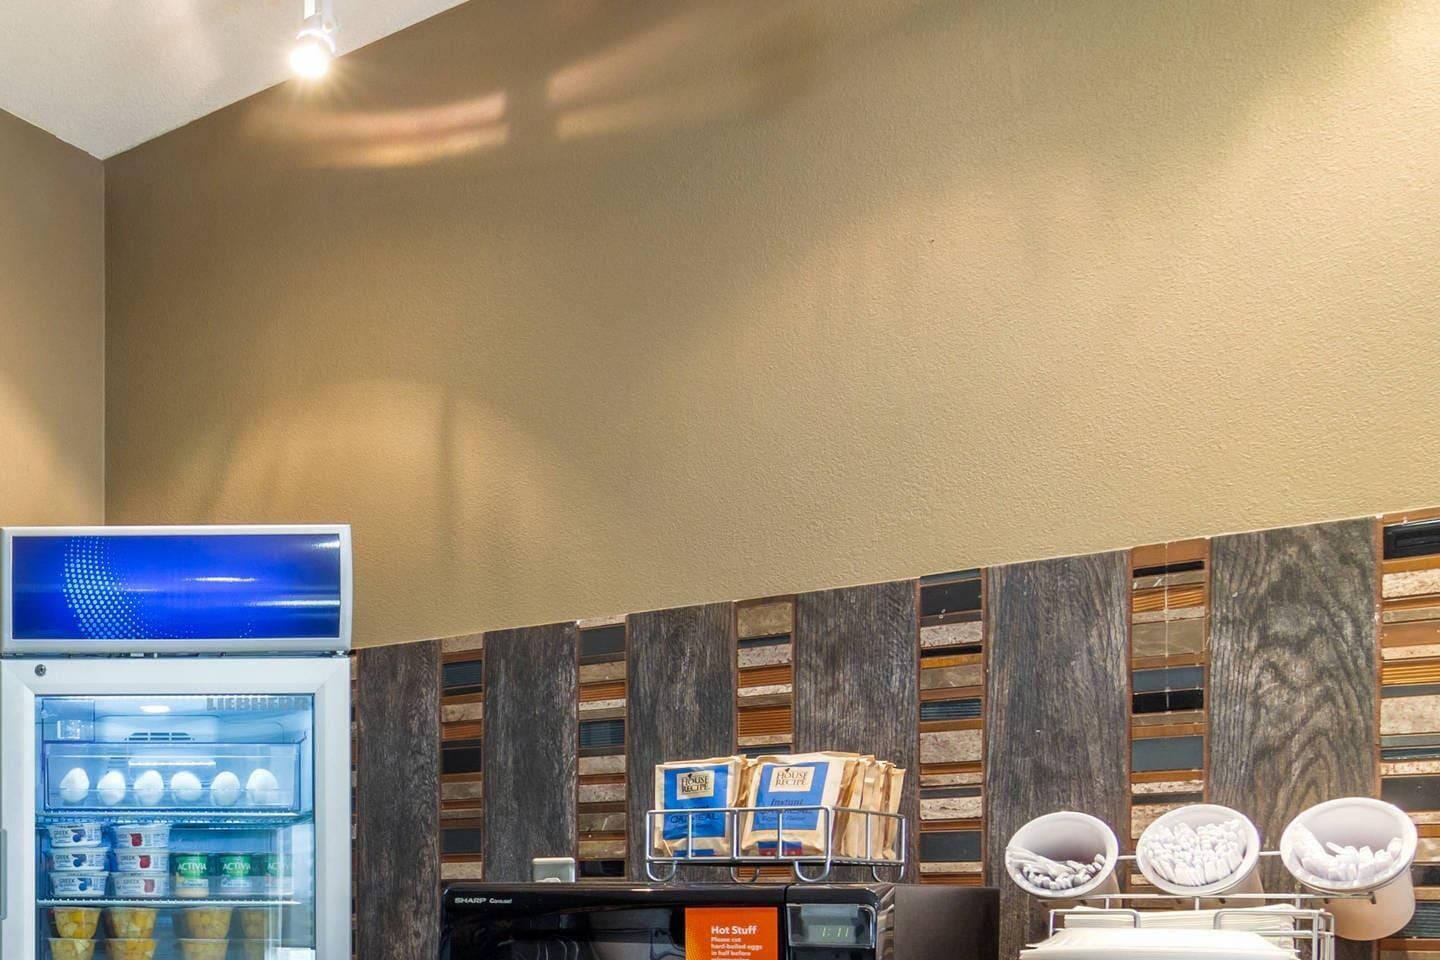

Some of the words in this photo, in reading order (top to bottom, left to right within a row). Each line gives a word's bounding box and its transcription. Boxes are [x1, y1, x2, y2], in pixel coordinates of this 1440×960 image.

[777, 769, 808, 779] HOUSE
[681, 774, 709, 785] HOUSE
[775, 778, 807, 786] RECIPE
[681, 784, 710, 793] RECIPE
[770, 798, 803, 806] Instant
[177, 862, 207, 871] ACTIVIA
[711, 925, 730, 935] Hot
[731, 925, 758, 935] Stuff
